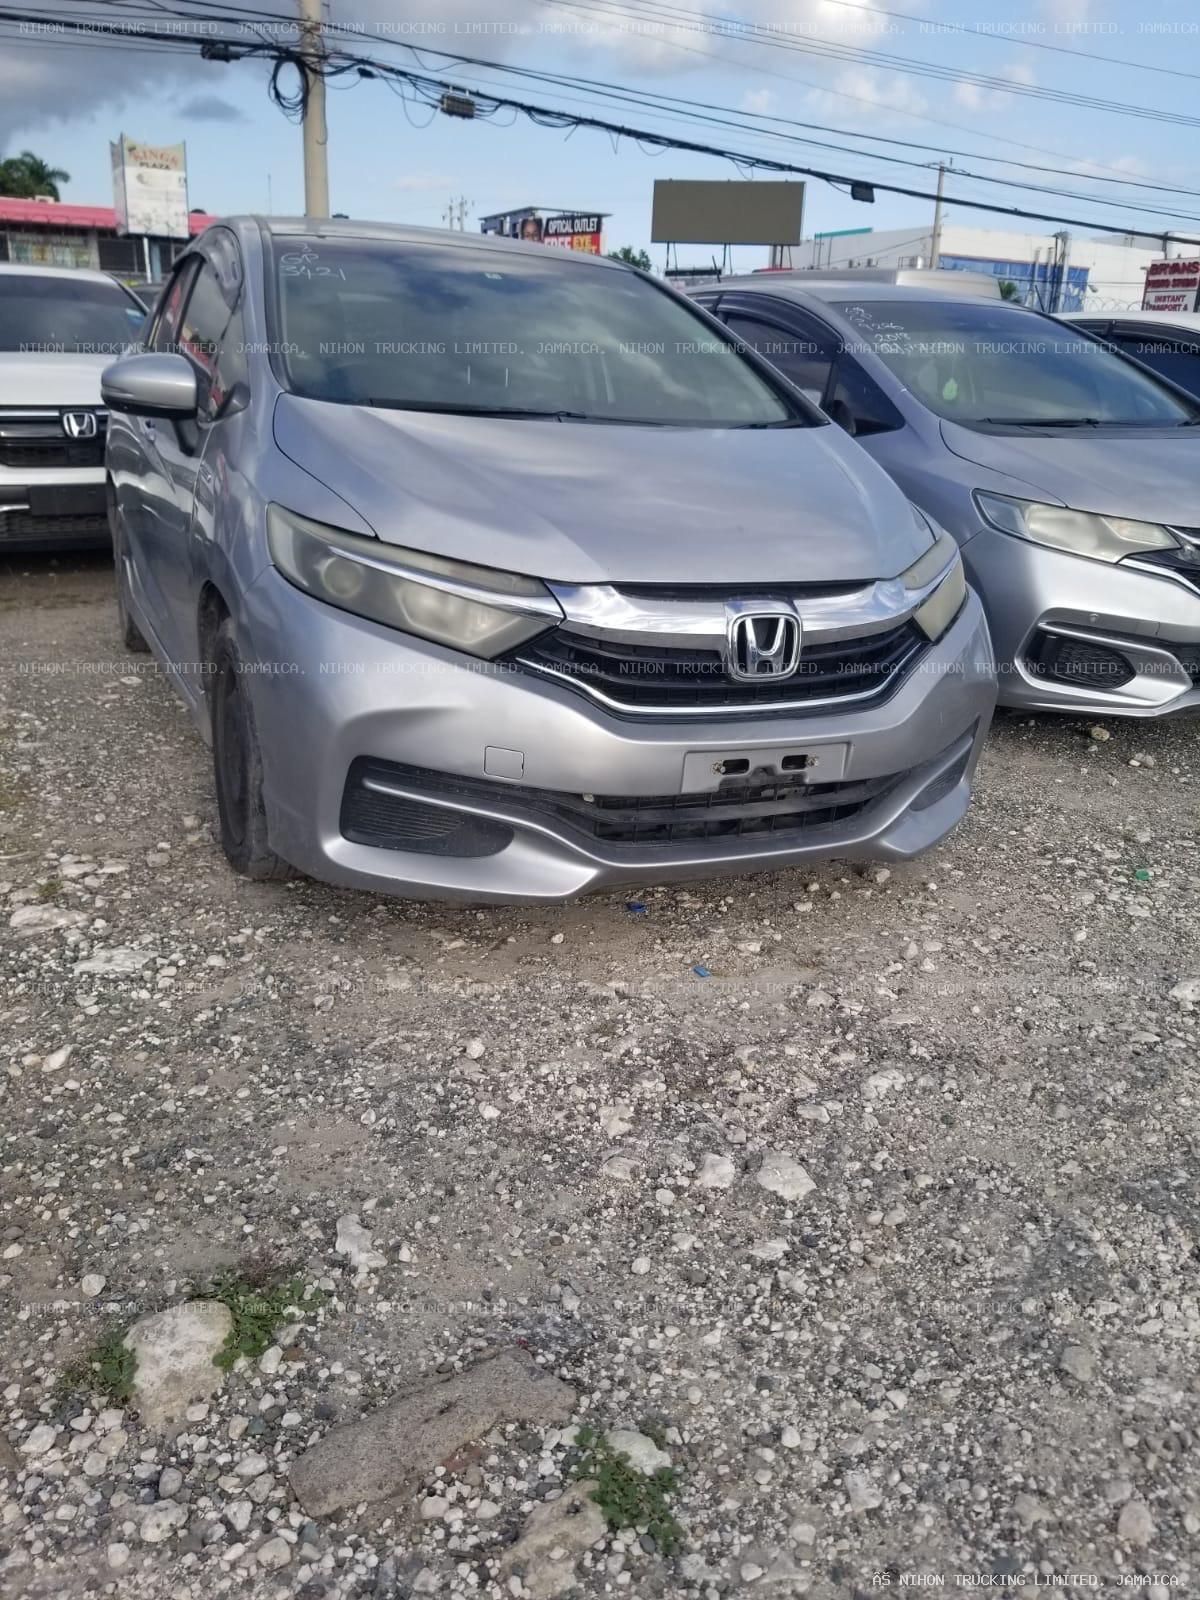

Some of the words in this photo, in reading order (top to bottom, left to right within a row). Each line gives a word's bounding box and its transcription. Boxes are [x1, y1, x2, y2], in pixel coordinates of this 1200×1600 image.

[132, 148, 178, 166] KINGS
[139, 161, 171, 170] PLAZA
[548, 219, 573, 234] OPTICAL
[573, 217, 598, 233] OUTLET
[1154, 294, 1186, 303] INSTANT
